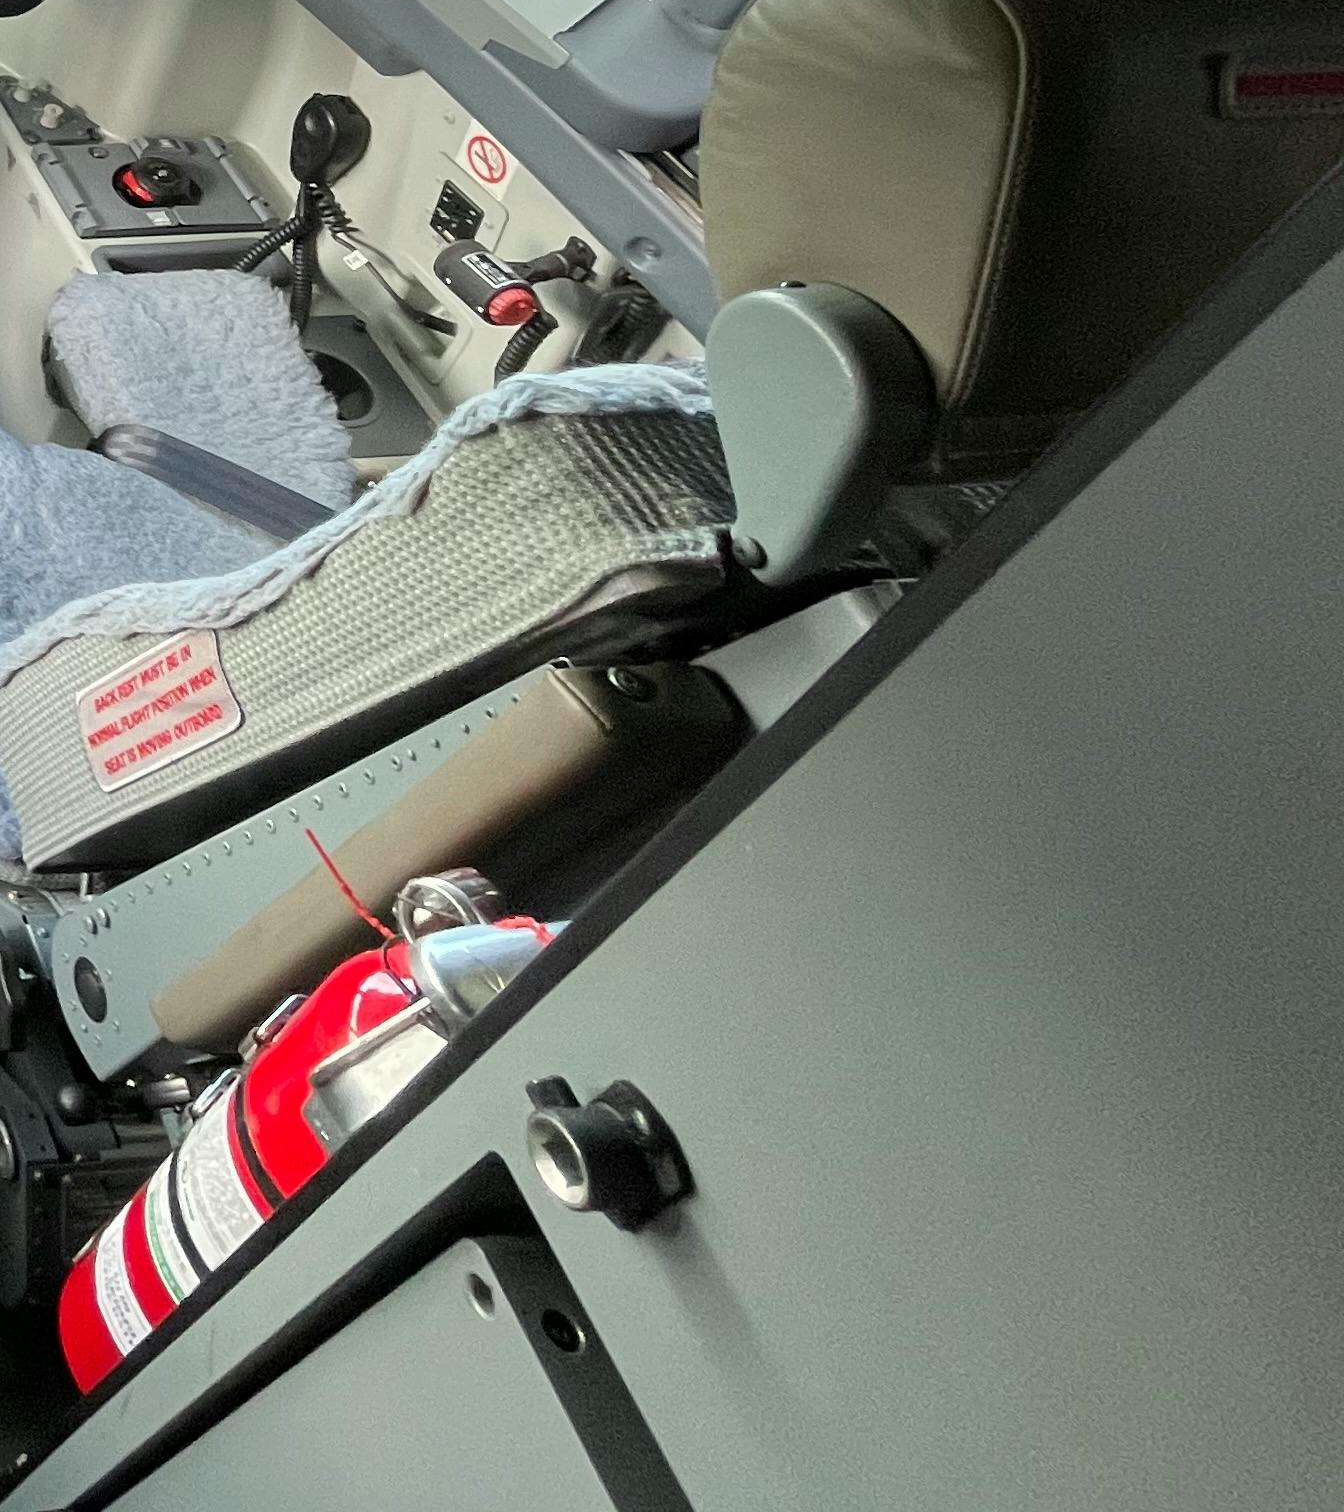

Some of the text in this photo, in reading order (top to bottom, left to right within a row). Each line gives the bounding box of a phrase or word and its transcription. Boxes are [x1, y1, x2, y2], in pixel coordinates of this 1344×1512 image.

[94, 690, 120, 713] BACK
[140, 661, 166, 687] MUST
[166, 652, 180, 672] BE
[180, 644, 193, 663] IN
[121, 704, 152, 730] FLIGHT
[104, 751, 128, 776] SEAT
